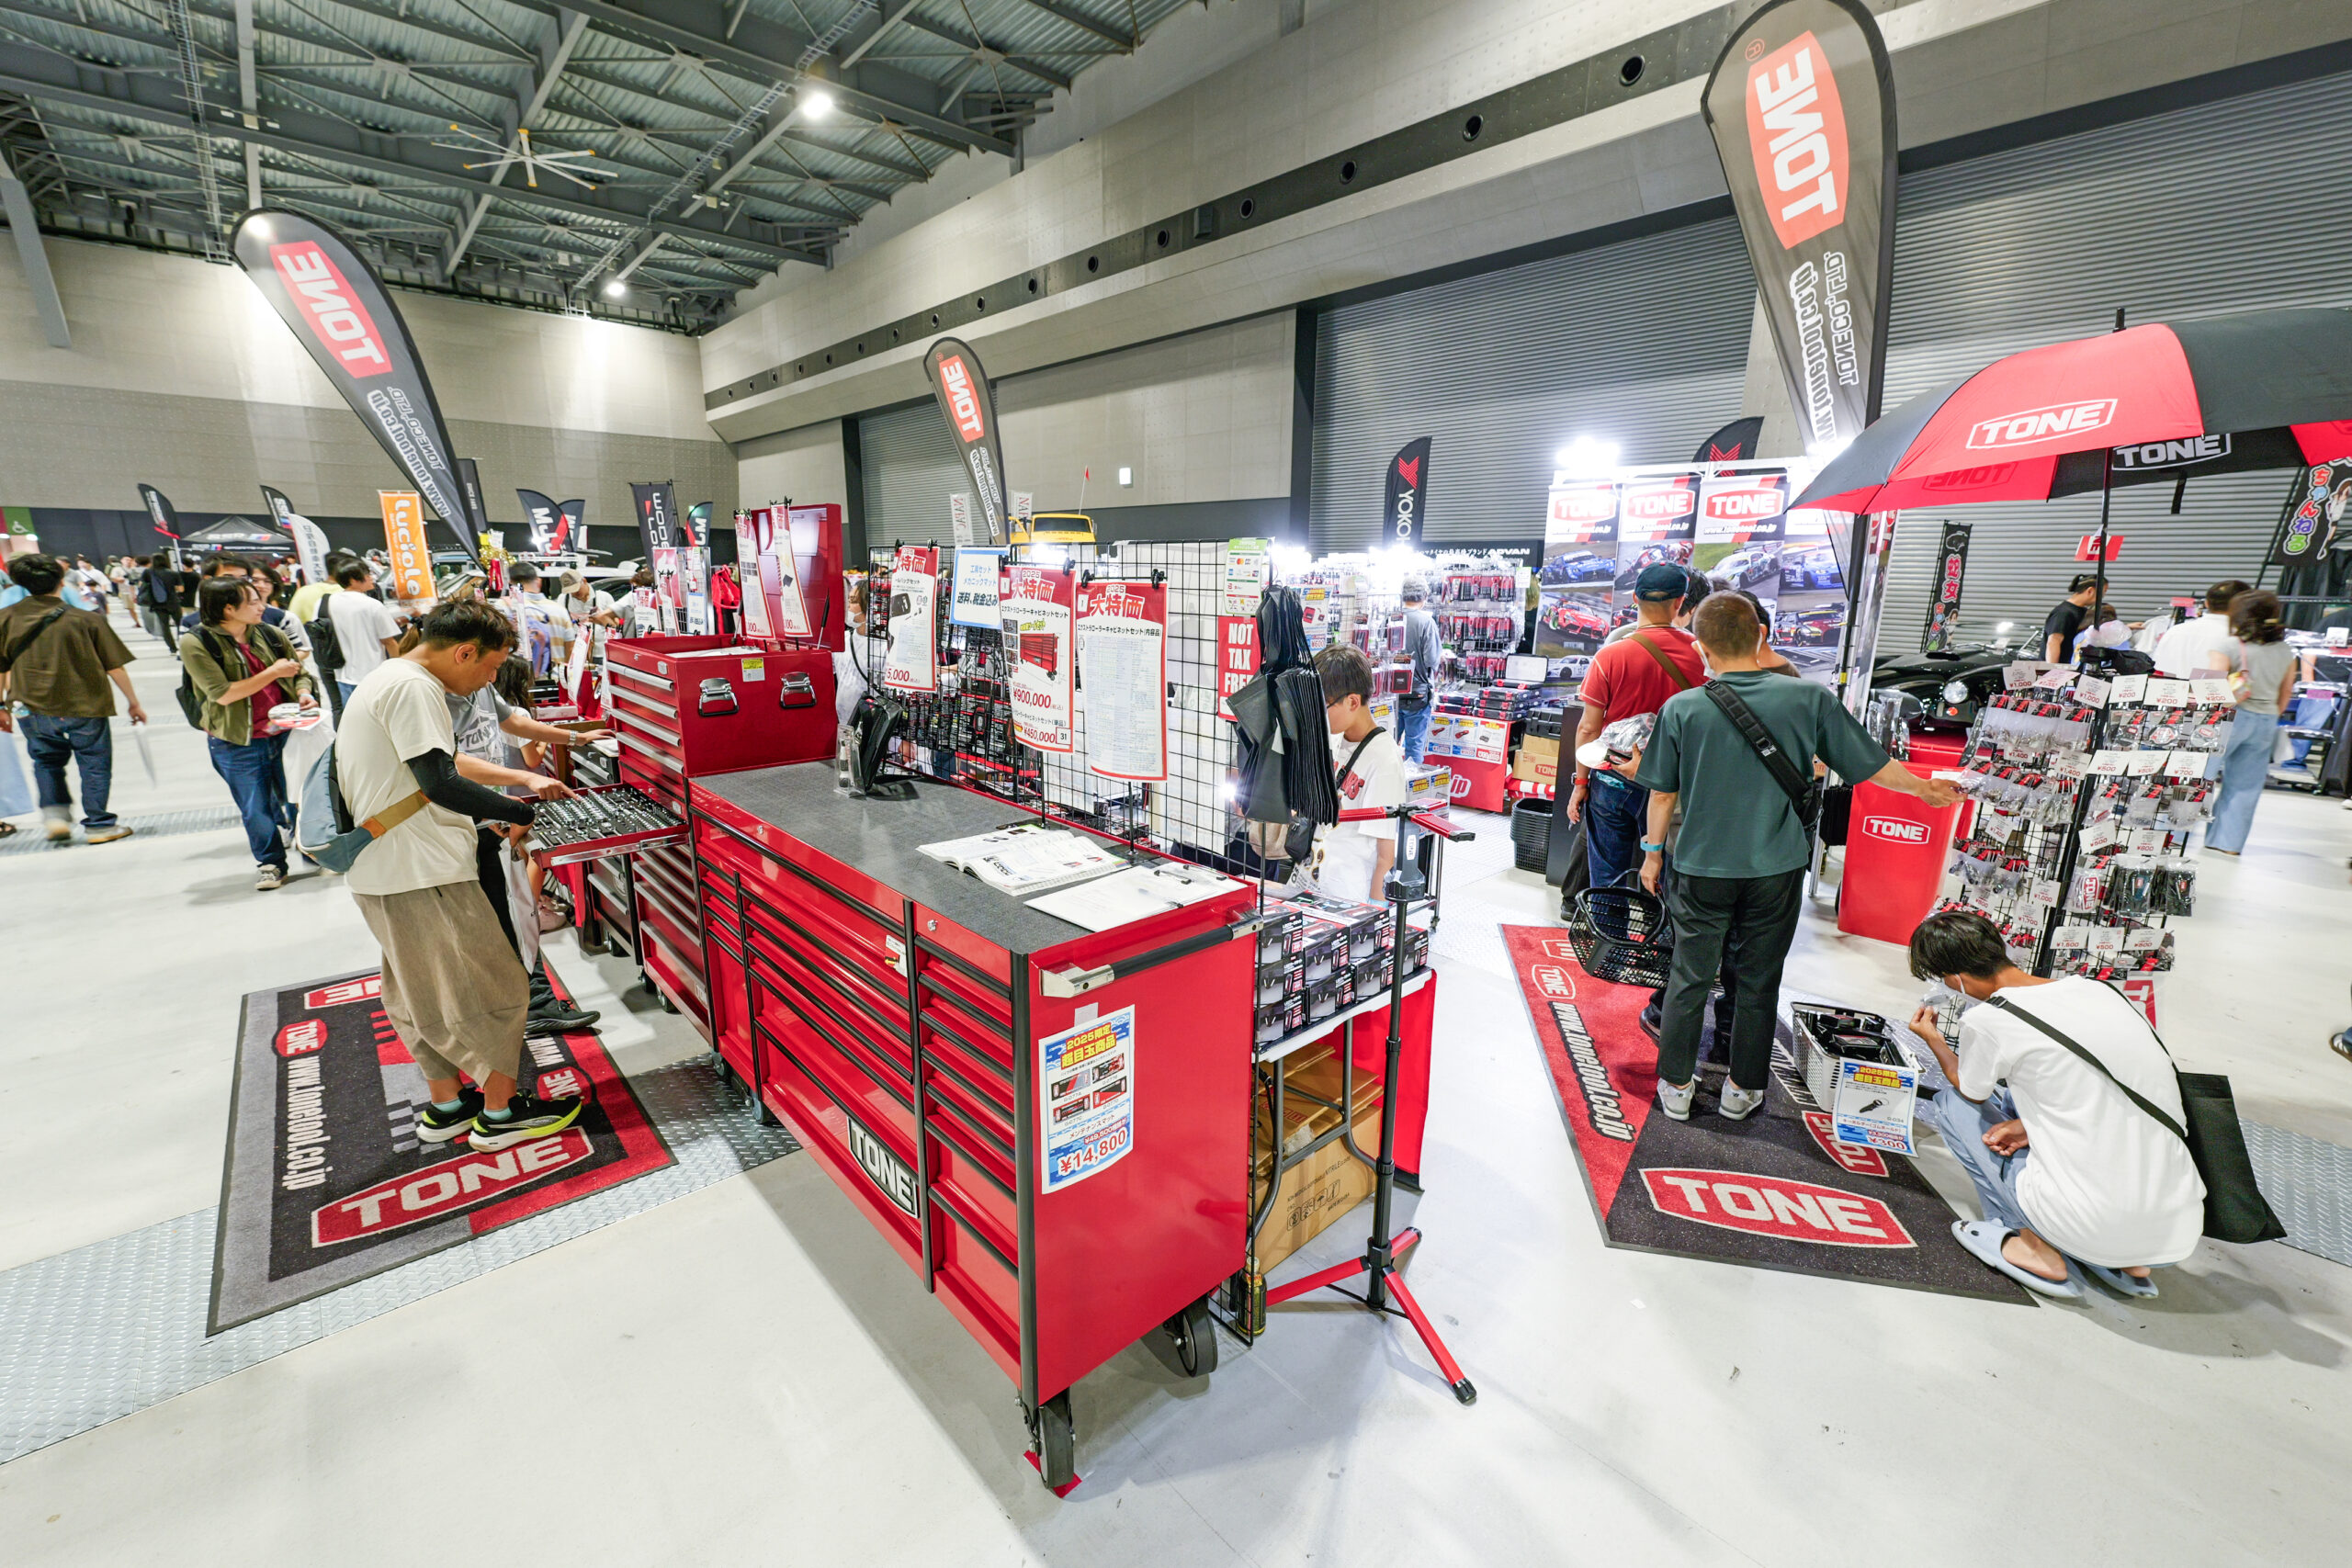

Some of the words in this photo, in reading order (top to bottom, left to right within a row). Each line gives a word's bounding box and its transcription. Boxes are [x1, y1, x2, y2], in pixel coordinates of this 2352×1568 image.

[1982, 403, 2102, 445] TONE
[2117, 434, 2222, 467] TONE
[1633, 494, 1688, 514] TONE
[1713, 494, 1777, 515] TONE
[2287, 468, 2330, 552] ちゃんねる
[394, 500, 423, 596] Luciole
[1023, 570, 1040, 579] 2025
[1012, 578, 1055, 603] 大特価
[1106, 585, 1125, 593] 2025
[1090, 593, 1145, 620] 大特価
[1228, 623, 1253, 645] NOT
[1228, 648, 1251, 671] TAX
[1224, 671, 1254, 694] FRE
[1013, 687, 1051, 708] ¥900,000
[2080, 692, 2100, 705] ¥1,000
[2060, 767, 2081, 777] ¥1,400
[1870, 818, 1924, 841] TONE
[2034, 894, 2052, 903] ¥1,000
[2085, 878, 2097, 909] TONE
[2018, 917, 2038, 926] ¥1,700
[1539, 968, 1568, 995] TONE
[286, 1021, 318, 1054] TONE
[1067, 1024, 1111, 1050] 2025限定
[1061, 1034, 1115, 1067] 超目玉商品
[543, 1069, 582, 1099] ONE
[1552, 1002, 1634, 1142] www.tonetool.co.jp
[1854, 1073, 1901, 1089] 超目玉商品
[1860, 1066, 1897, 1079] 2025限定
[281, 1056, 334, 1191] www.tonetool.co.jp
[1069, 1114, 1114, 1139] メンテナンスマット
[1060, 1129, 1126, 1173] ¥14,800
[1868, 1136, 1905, 1150] ¥300
[851, 1121, 912, 1211] TONE
[341, 1137, 571, 1228] TONE
[1663, 1176, 1889, 1239] TONE
